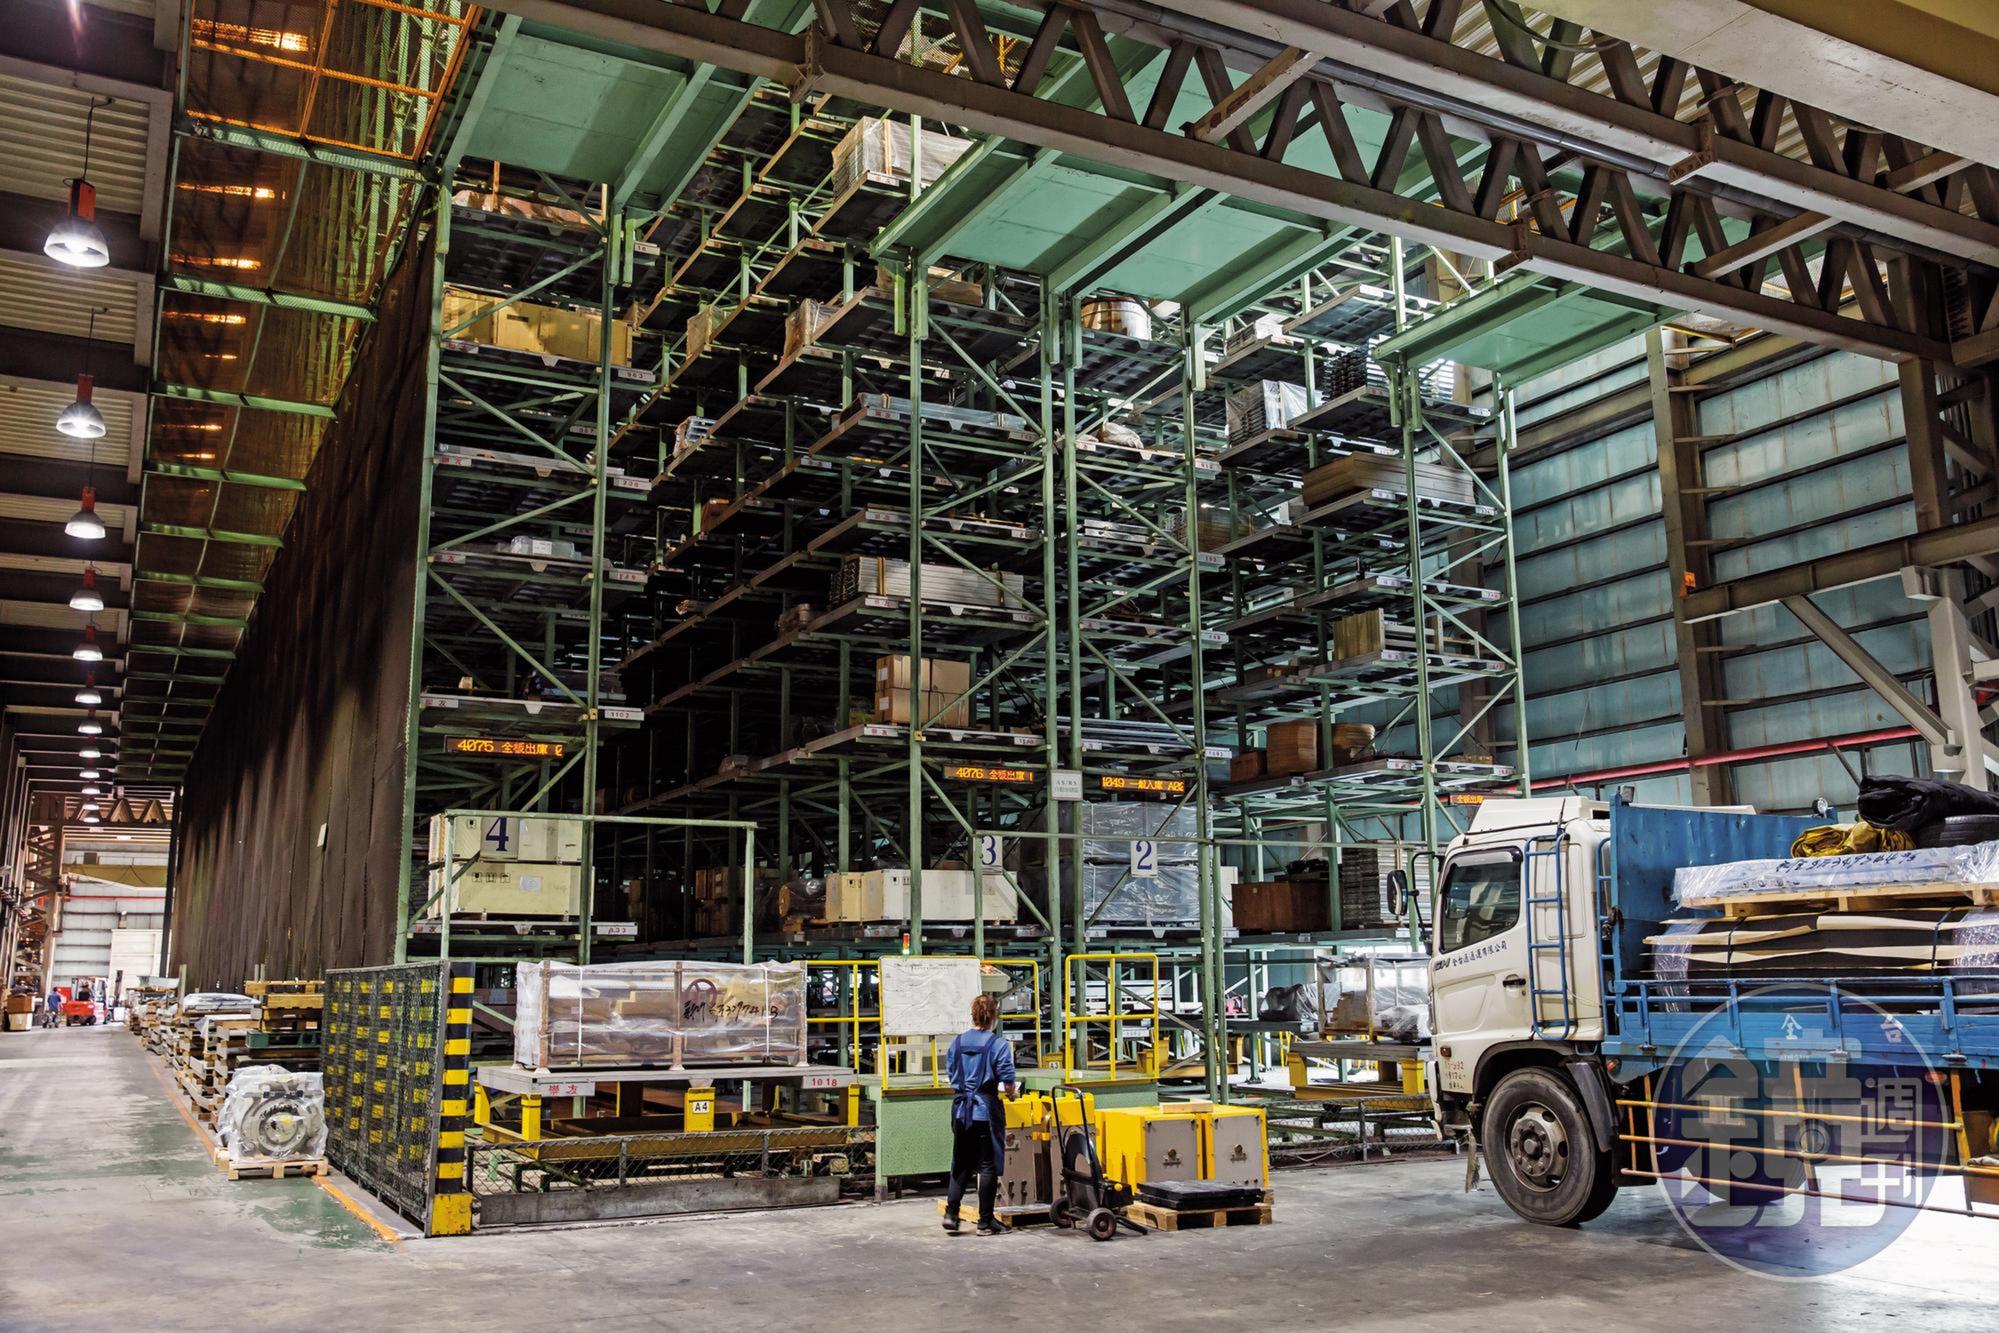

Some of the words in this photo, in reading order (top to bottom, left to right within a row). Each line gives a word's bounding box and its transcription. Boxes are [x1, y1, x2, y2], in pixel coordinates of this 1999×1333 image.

[457, 739, 495, 753] 4075
[956, 767, 984, 779] 4076
[485, 816, 509, 852] 4
[979, 834, 997, 866] 3
[1135, 840, 1153, 870] 2
[812, 1077, 838, 1087] 1018
[694, 1102, 708, 1112] A4
